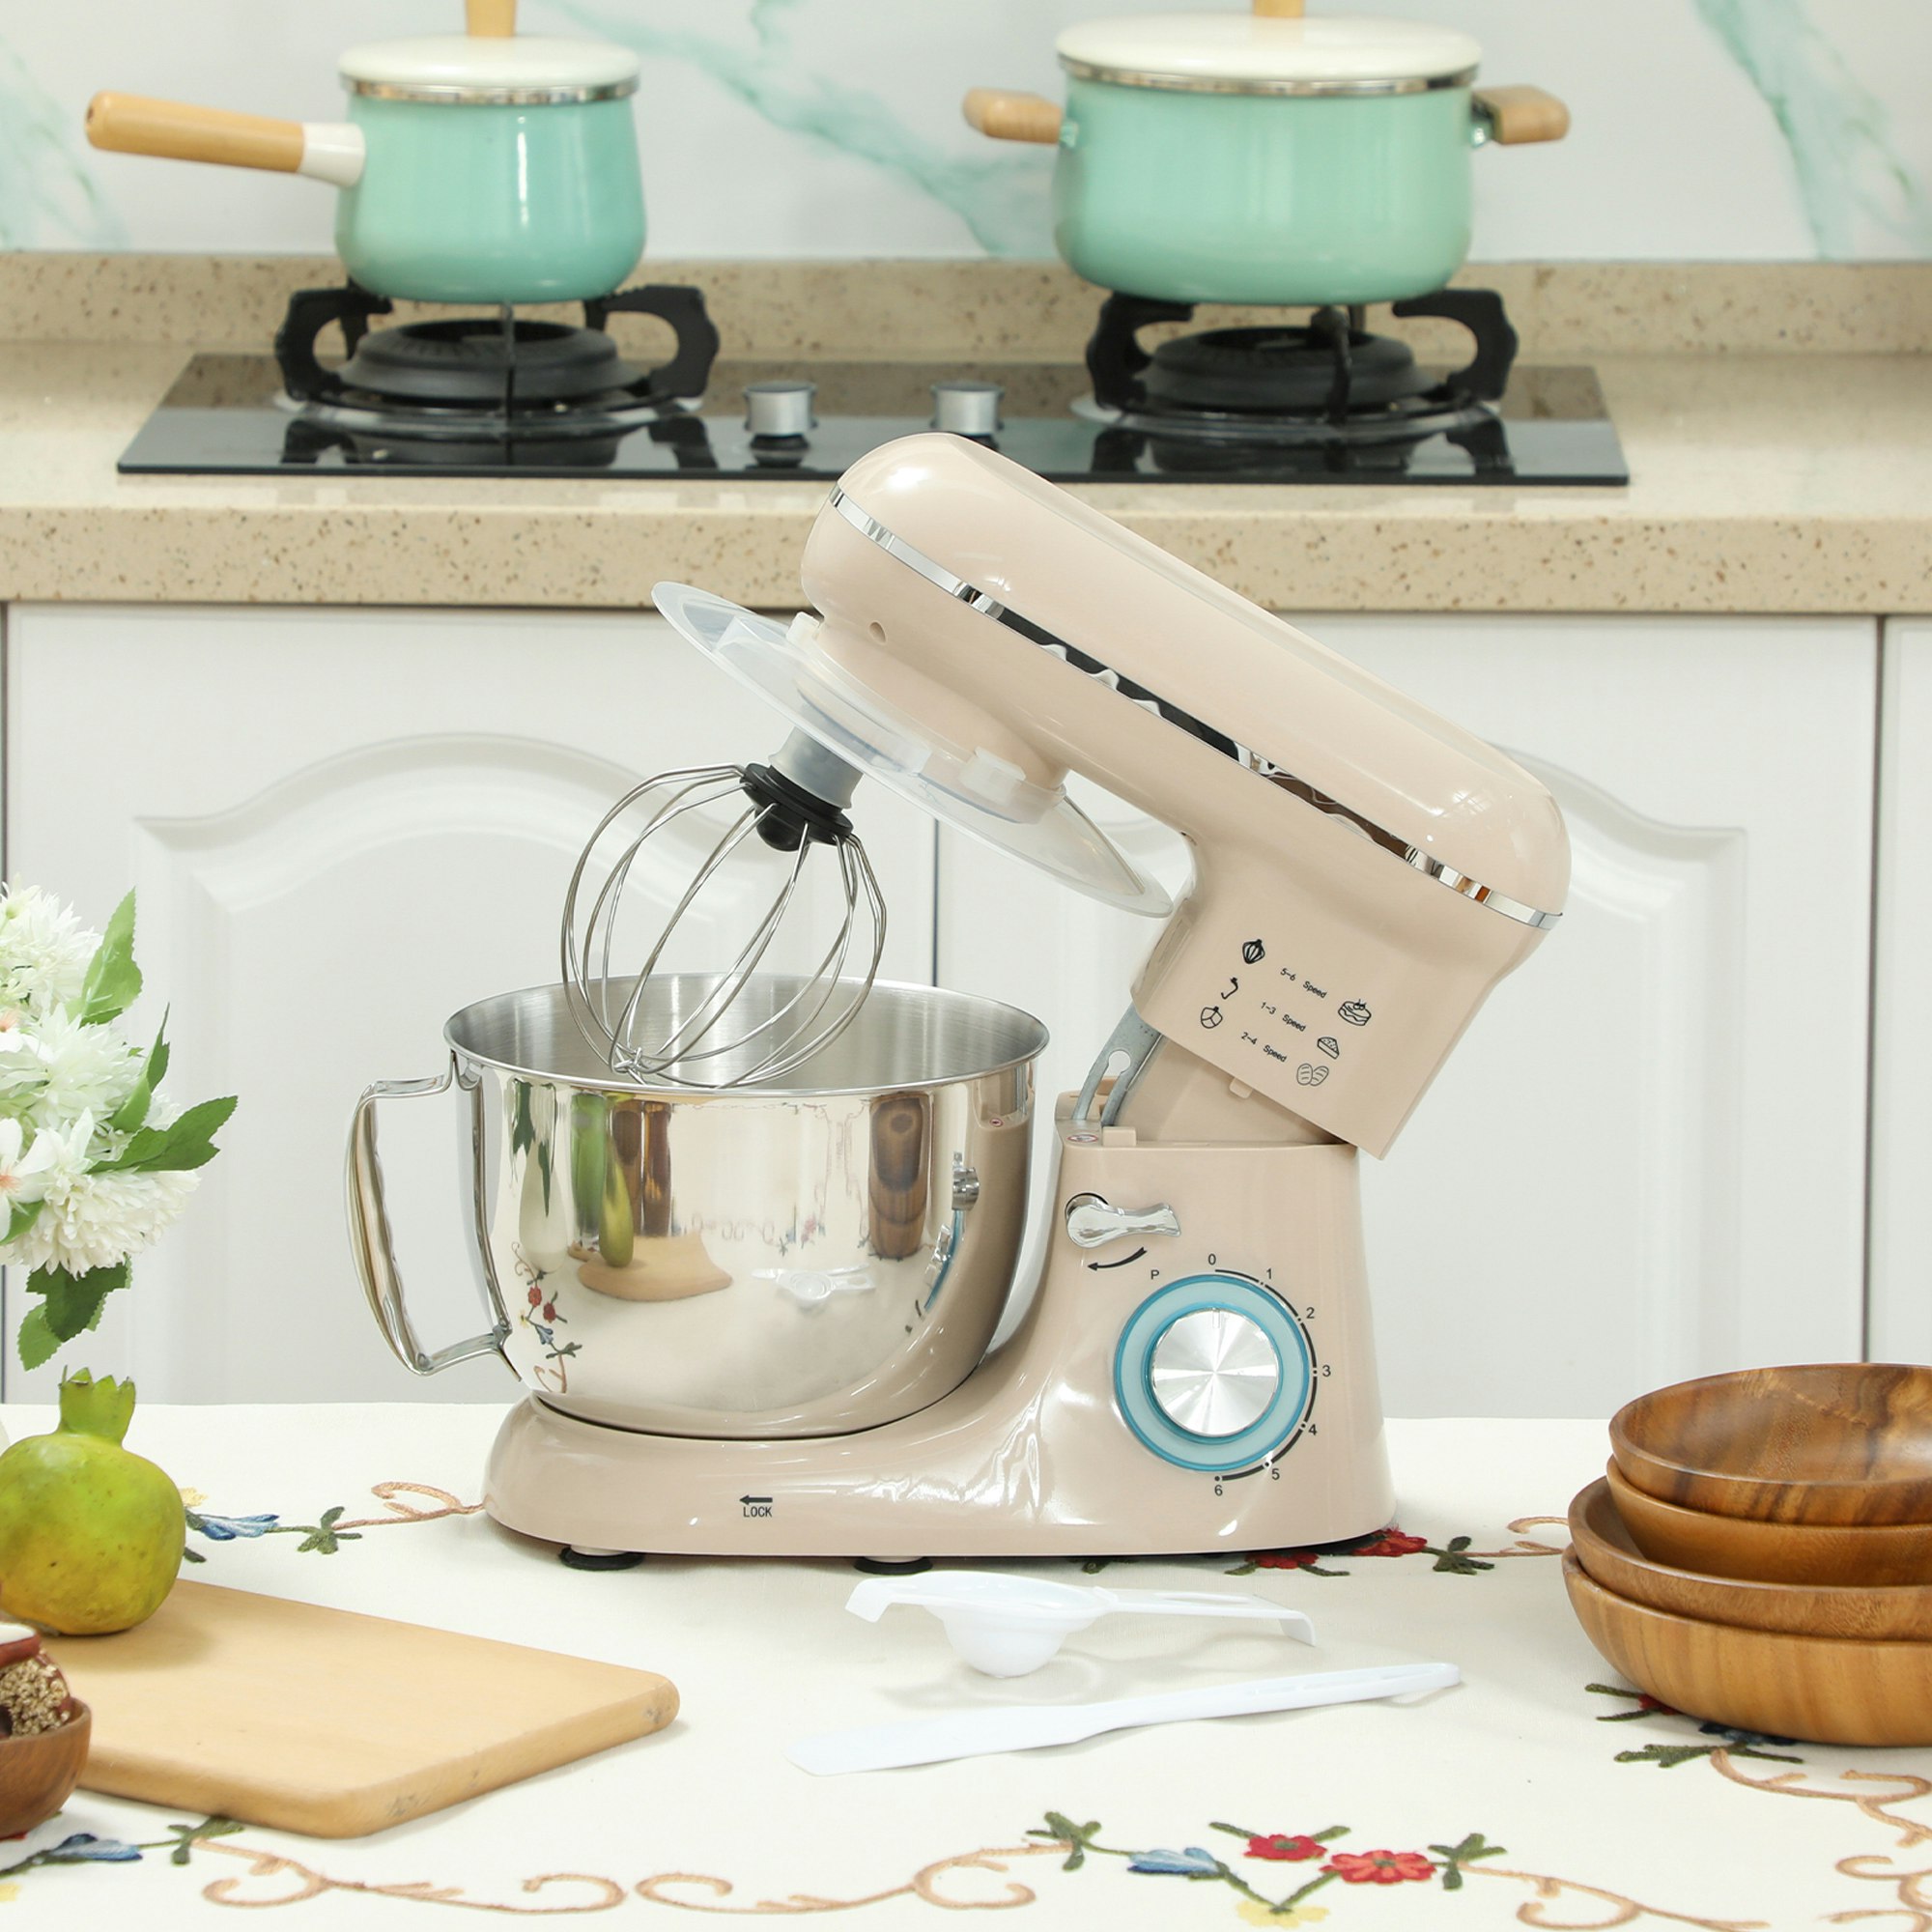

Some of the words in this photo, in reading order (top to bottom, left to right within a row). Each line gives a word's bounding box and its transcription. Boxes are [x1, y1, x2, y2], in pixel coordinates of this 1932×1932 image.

[1280, 967, 1296, 981] 5-6
[1302, 980, 1328, 999] Speed
[1261, 1001, 1277, 1015] 1-3
[1281, 1013, 1307, 1033] Speed
[1240, 1031, 1258, 1045] 2-4
[1263, 1044, 1288, 1063] Speed
[1150, 1268, 1160, 1281] P
[1265, 1267, 1272, 1280] 1
[1305, 1306, 1316, 1320] 2
[1321, 1364, 1332, 1378] 3
[1307, 1423, 1319, 1436] 4
[1271, 1467, 1281, 1481] 5
[1213, 1484, 1224, 1497] 6
[743, 1505, 773, 1519] LOCK
